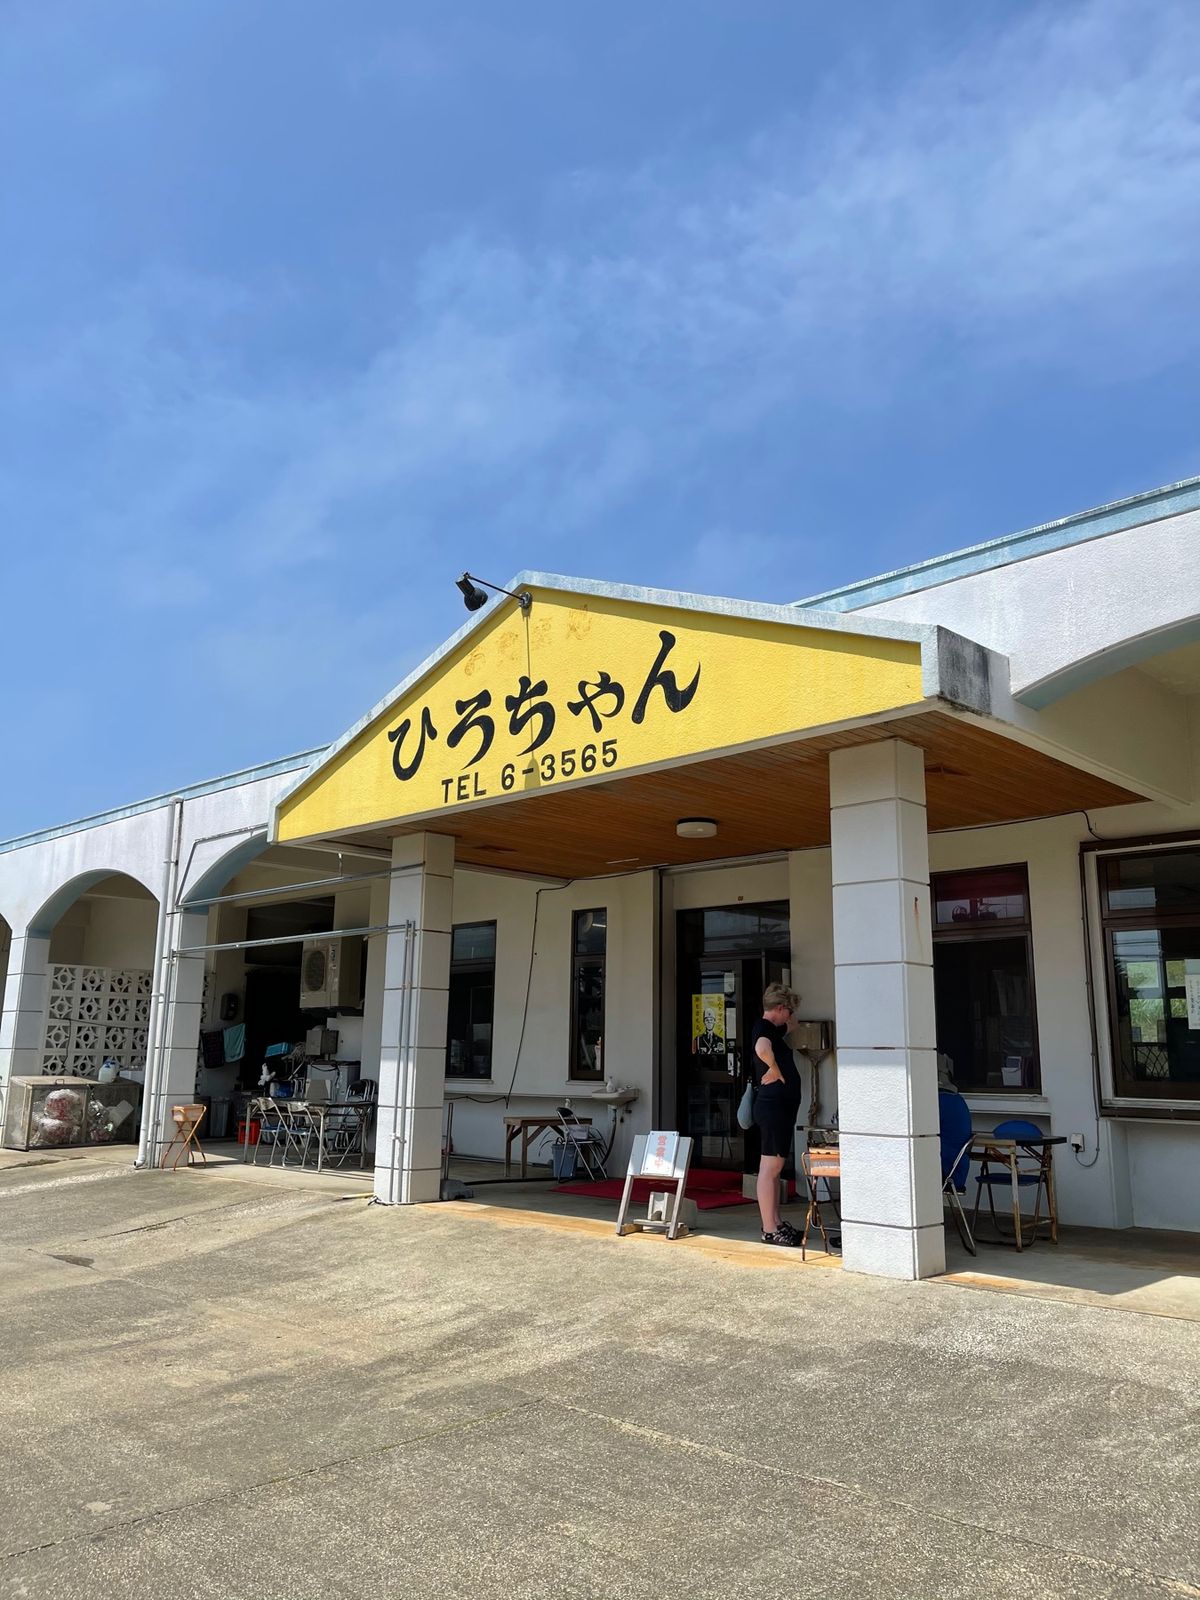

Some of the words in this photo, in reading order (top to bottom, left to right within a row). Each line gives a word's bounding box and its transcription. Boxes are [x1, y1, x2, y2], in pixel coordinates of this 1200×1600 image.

[388, 630, 701, 782] ひろちゃん
[441, 774, 487, 803] TEL
[501, 739, 619, 791] 6-3565
